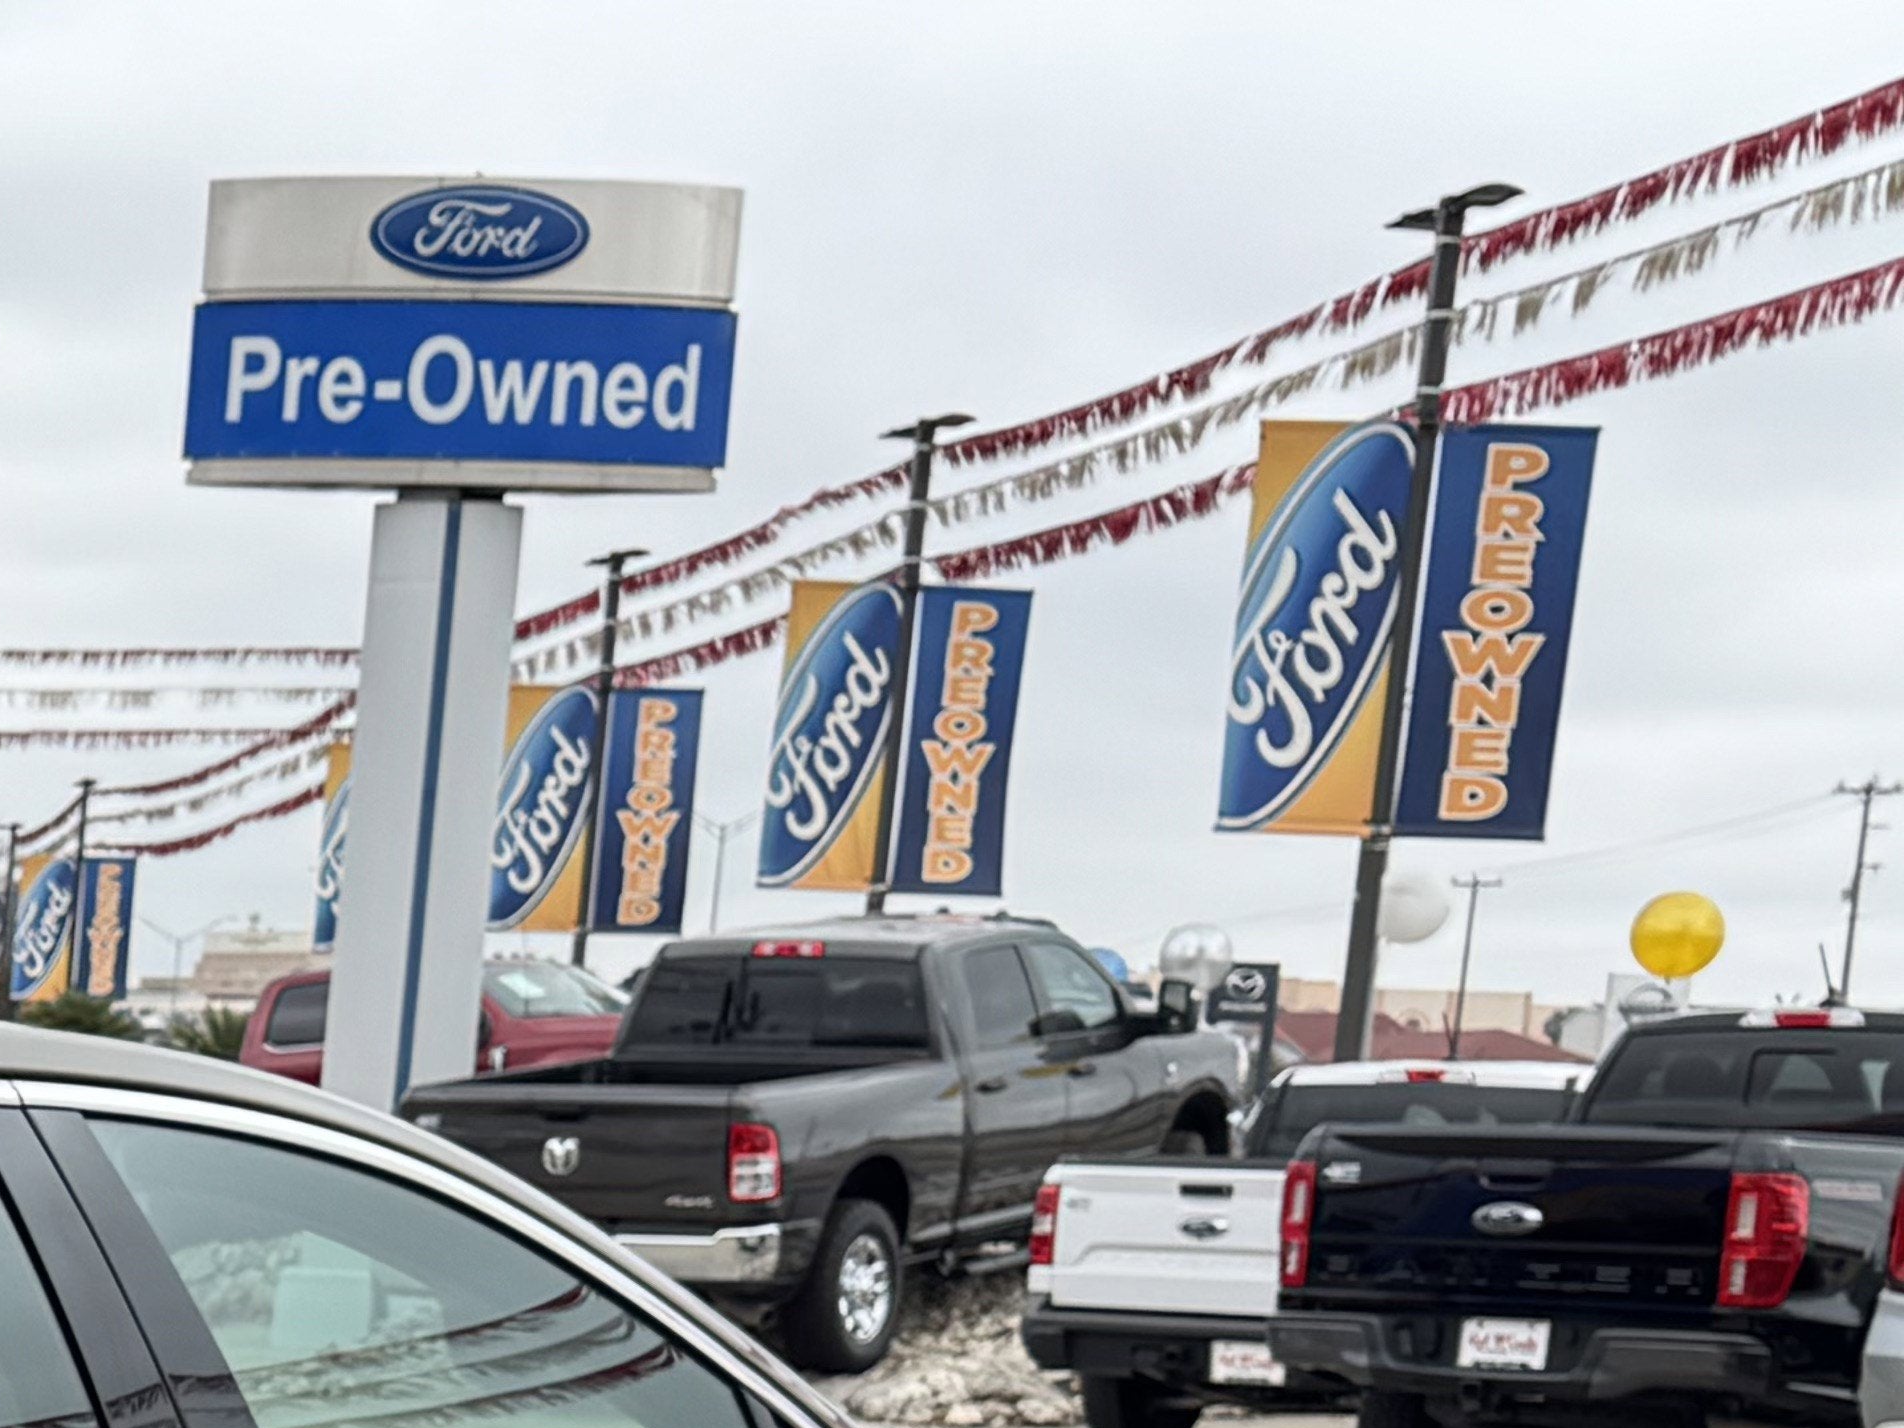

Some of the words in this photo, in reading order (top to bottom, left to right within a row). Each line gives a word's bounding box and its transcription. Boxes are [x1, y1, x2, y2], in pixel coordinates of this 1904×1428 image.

[414, 199, 542, 259] Ford
[224, 335, 702, 432] Pre-Owned
[1227, 487, 1397, 769] Ford
[1437, 442, 1550, 821] PREOWNED
[491, 724, 590, 894] Ford
[615, 697, 682, 926] PREOWNED
[765, 630, 890, 841] Ford
[921, 600, 1000, 884] PREOWNED
[12, 878, 72, 978] Ford
